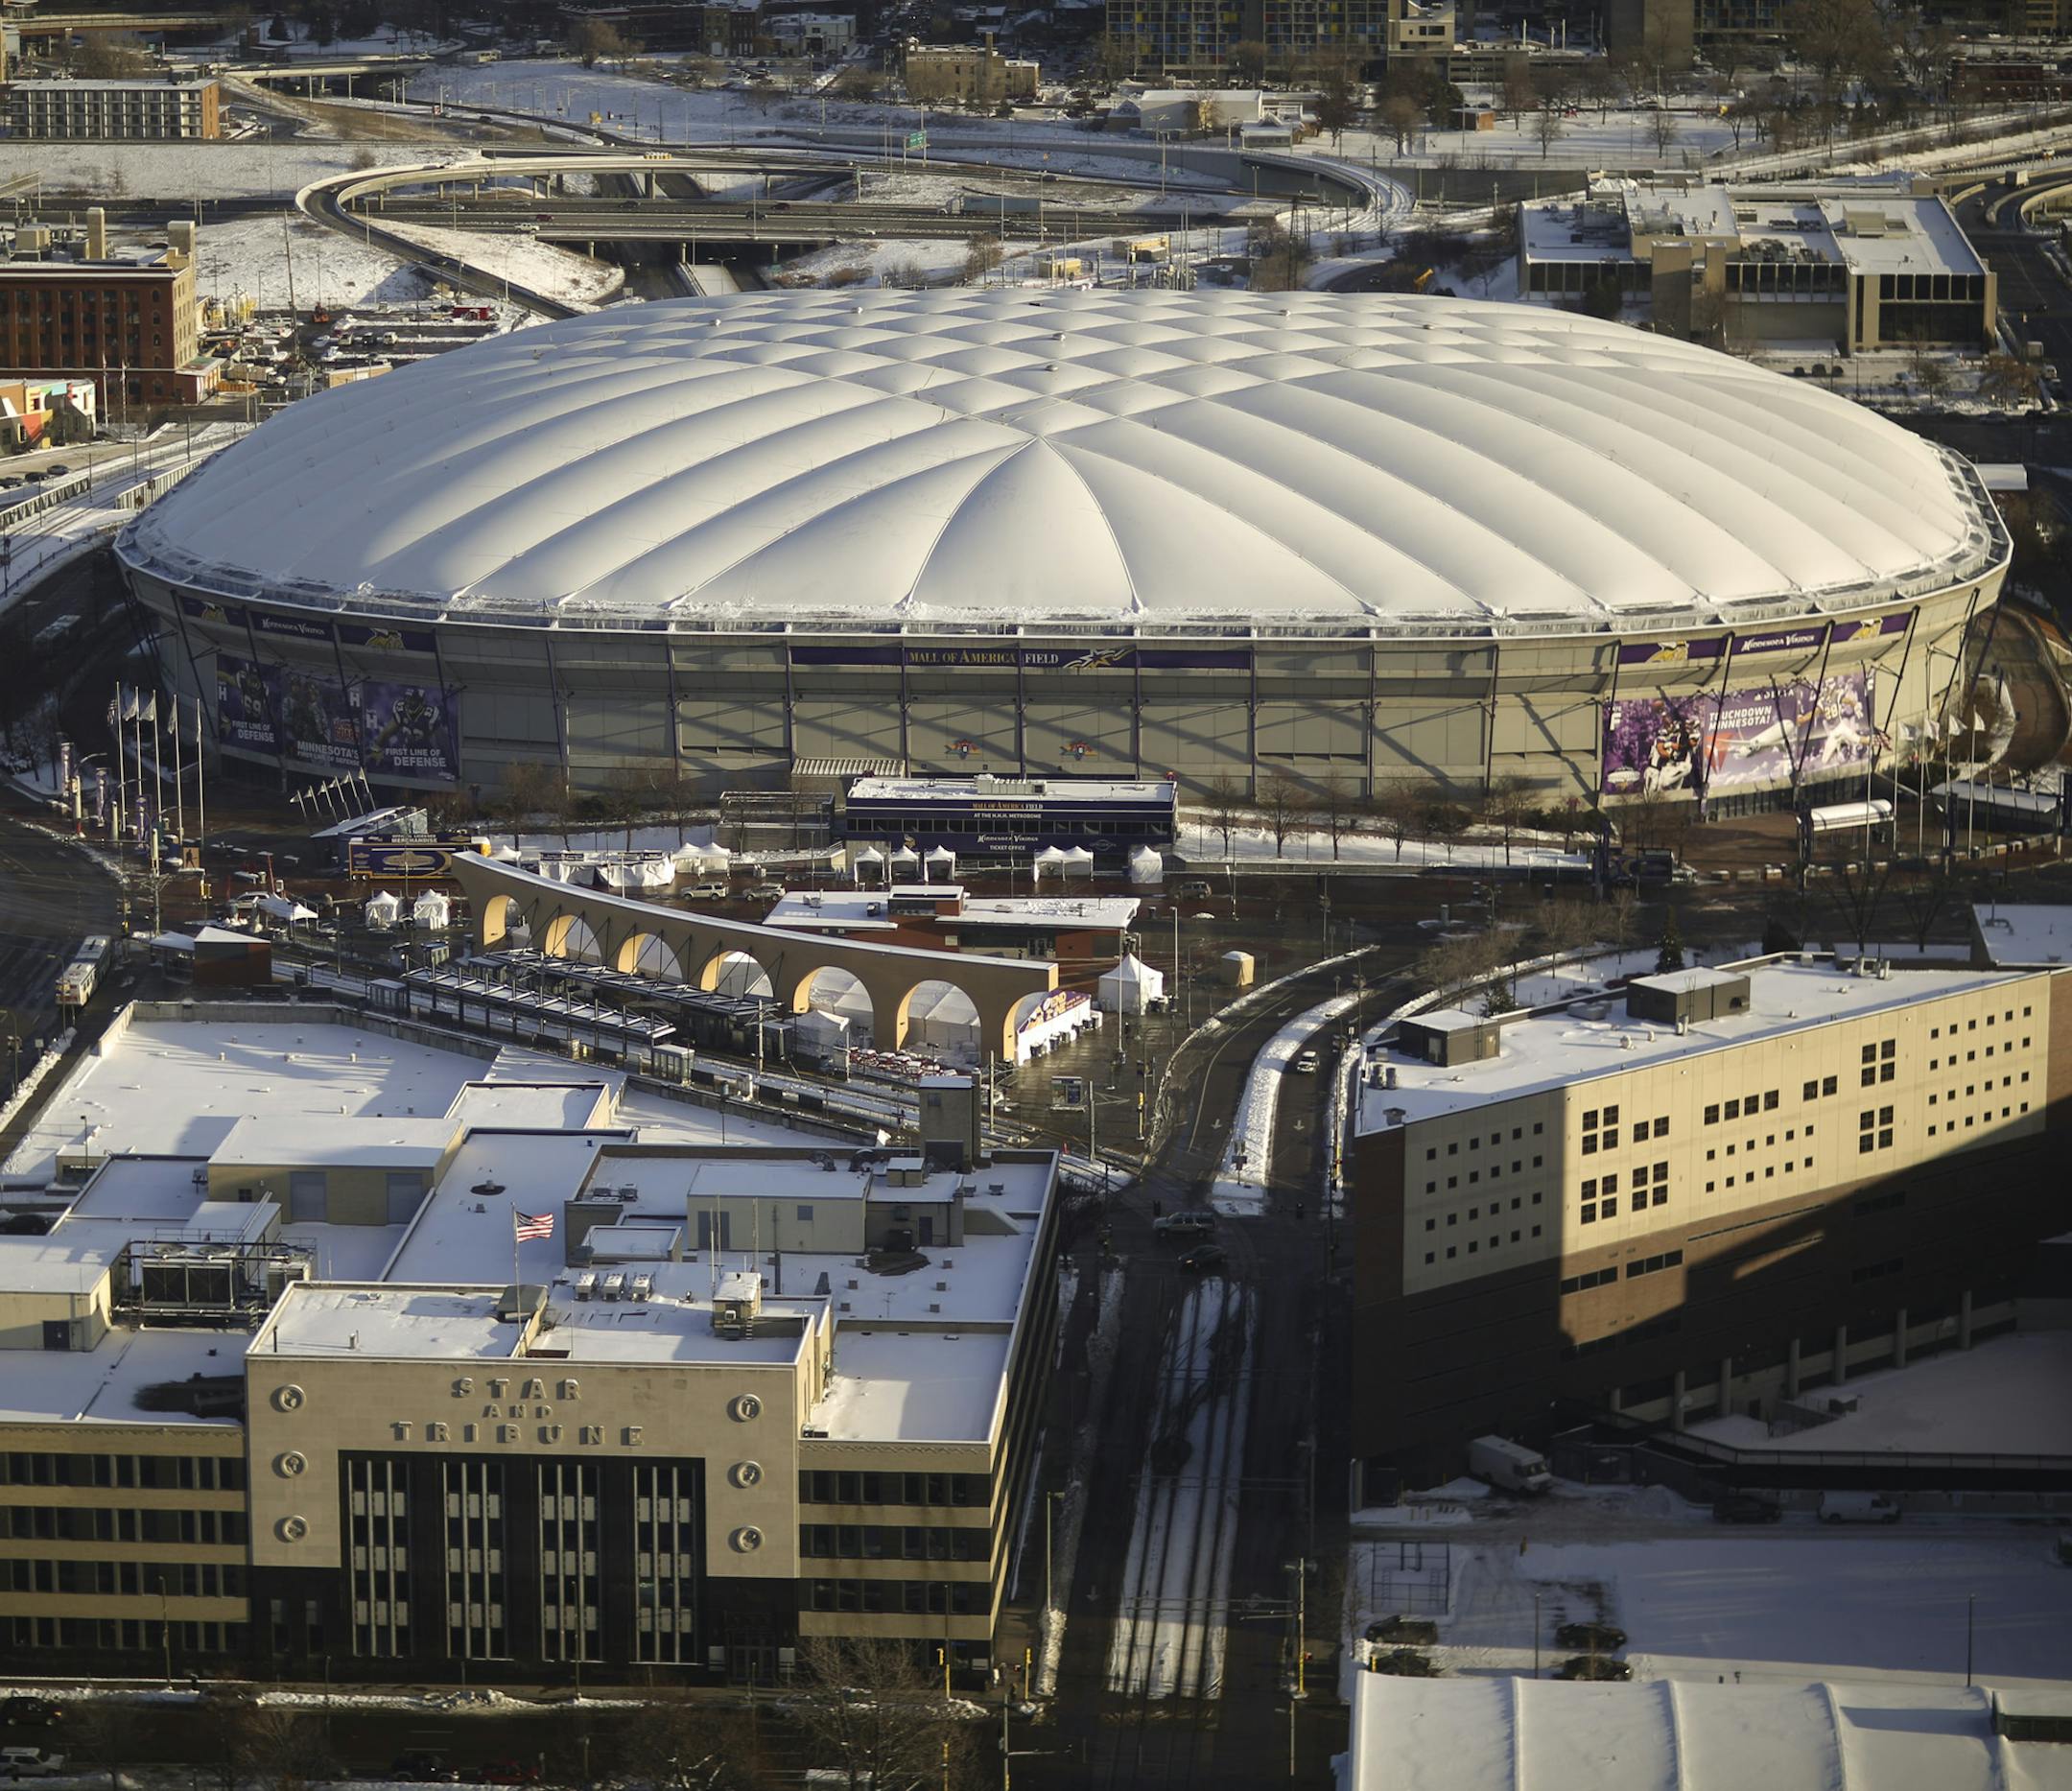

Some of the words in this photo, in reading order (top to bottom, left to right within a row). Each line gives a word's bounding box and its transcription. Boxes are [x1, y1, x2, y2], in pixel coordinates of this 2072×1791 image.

[909, 651, 938, 663] MALL
[942, 651, 958, 663] OF
[959, 650, 1016, 663] AMERICA
[1024, 652, 1059, 664] FIELD
[349, 692, 361, 707] H
[365, 714, 378, 729] H
[237, 729, 275, 742] DEFENSE
[386, 747, 408, 756] FIRST
[393, 756, 447, 767] DEFENSE
[458, 1377, 581, 1401] STAR
[485, 1404, 553, 1419] AND
[394, 1421, 645, 1446] TRIBUNE
